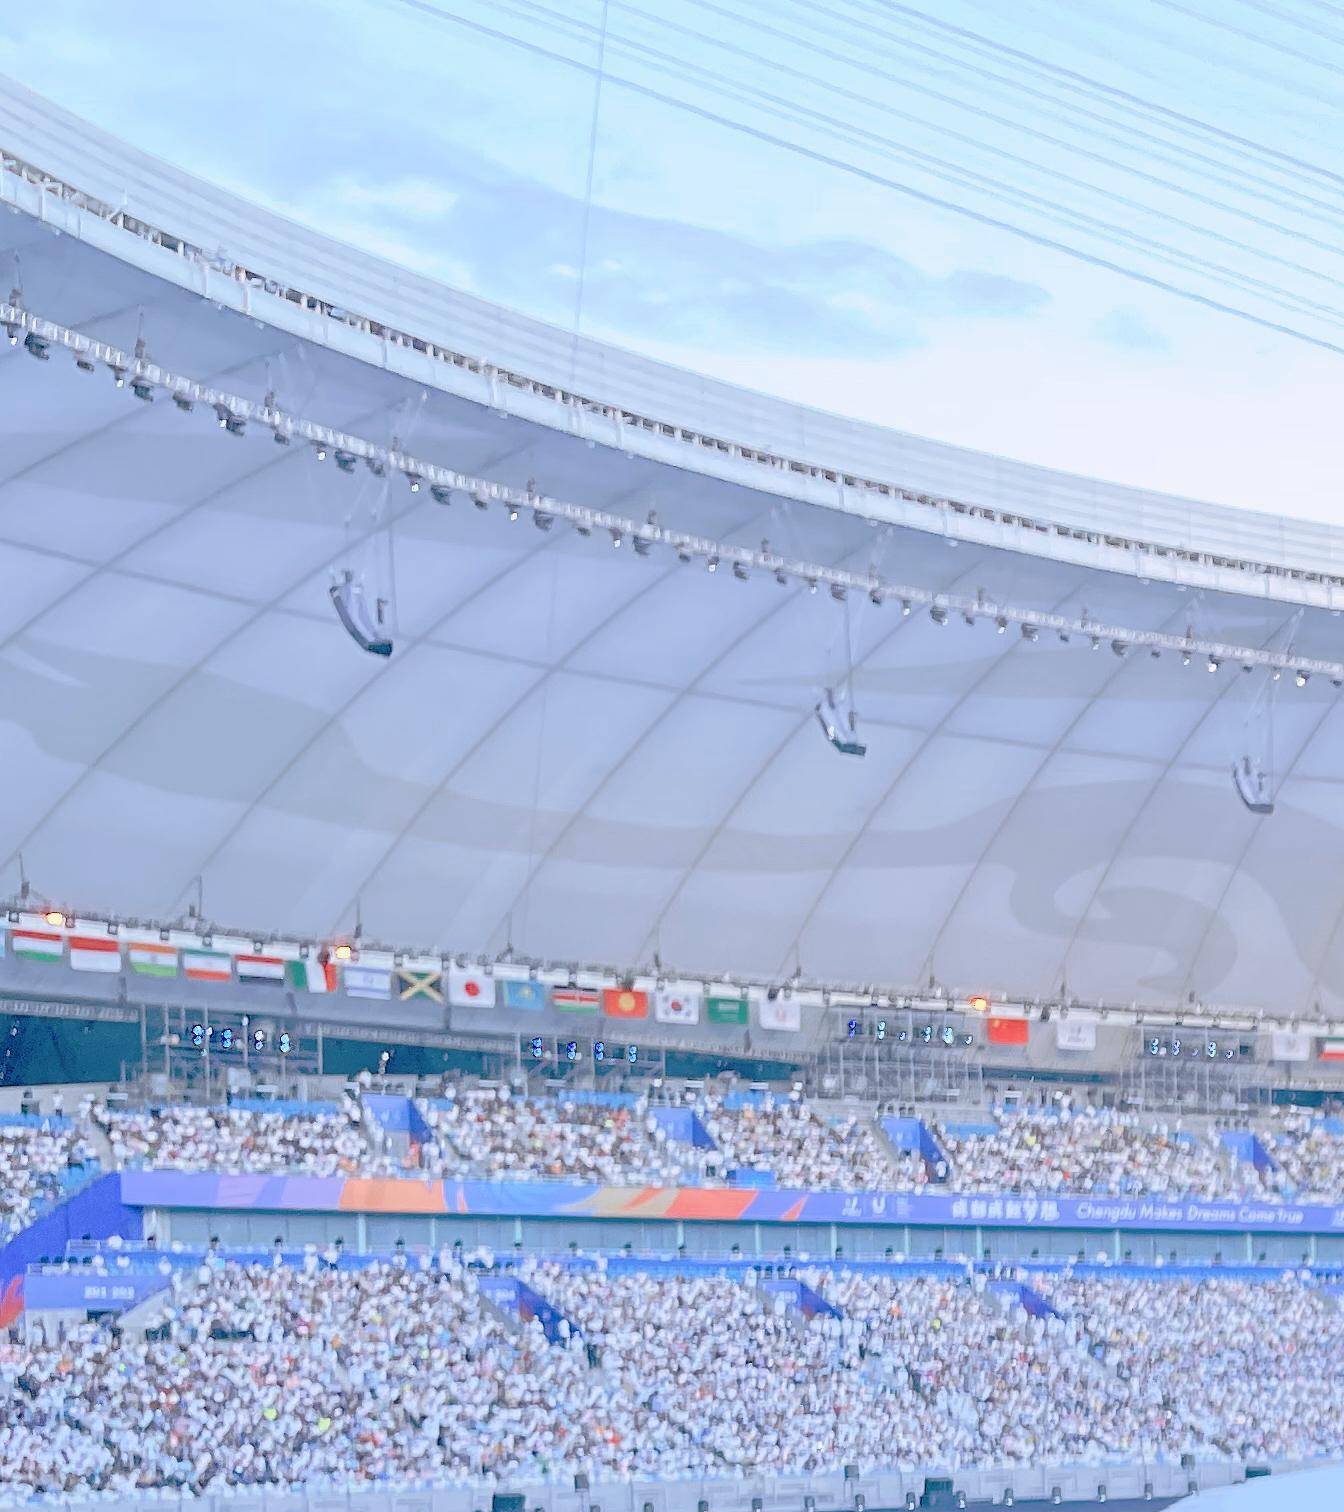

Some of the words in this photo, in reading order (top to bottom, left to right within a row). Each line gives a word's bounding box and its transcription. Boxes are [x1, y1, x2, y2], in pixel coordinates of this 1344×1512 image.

[1076, 1201, 1137, 1223] Chengdu
[1139, 1204, 1183, 1221] Makes
[1187, 1205, 1236, 1223] Dreams
